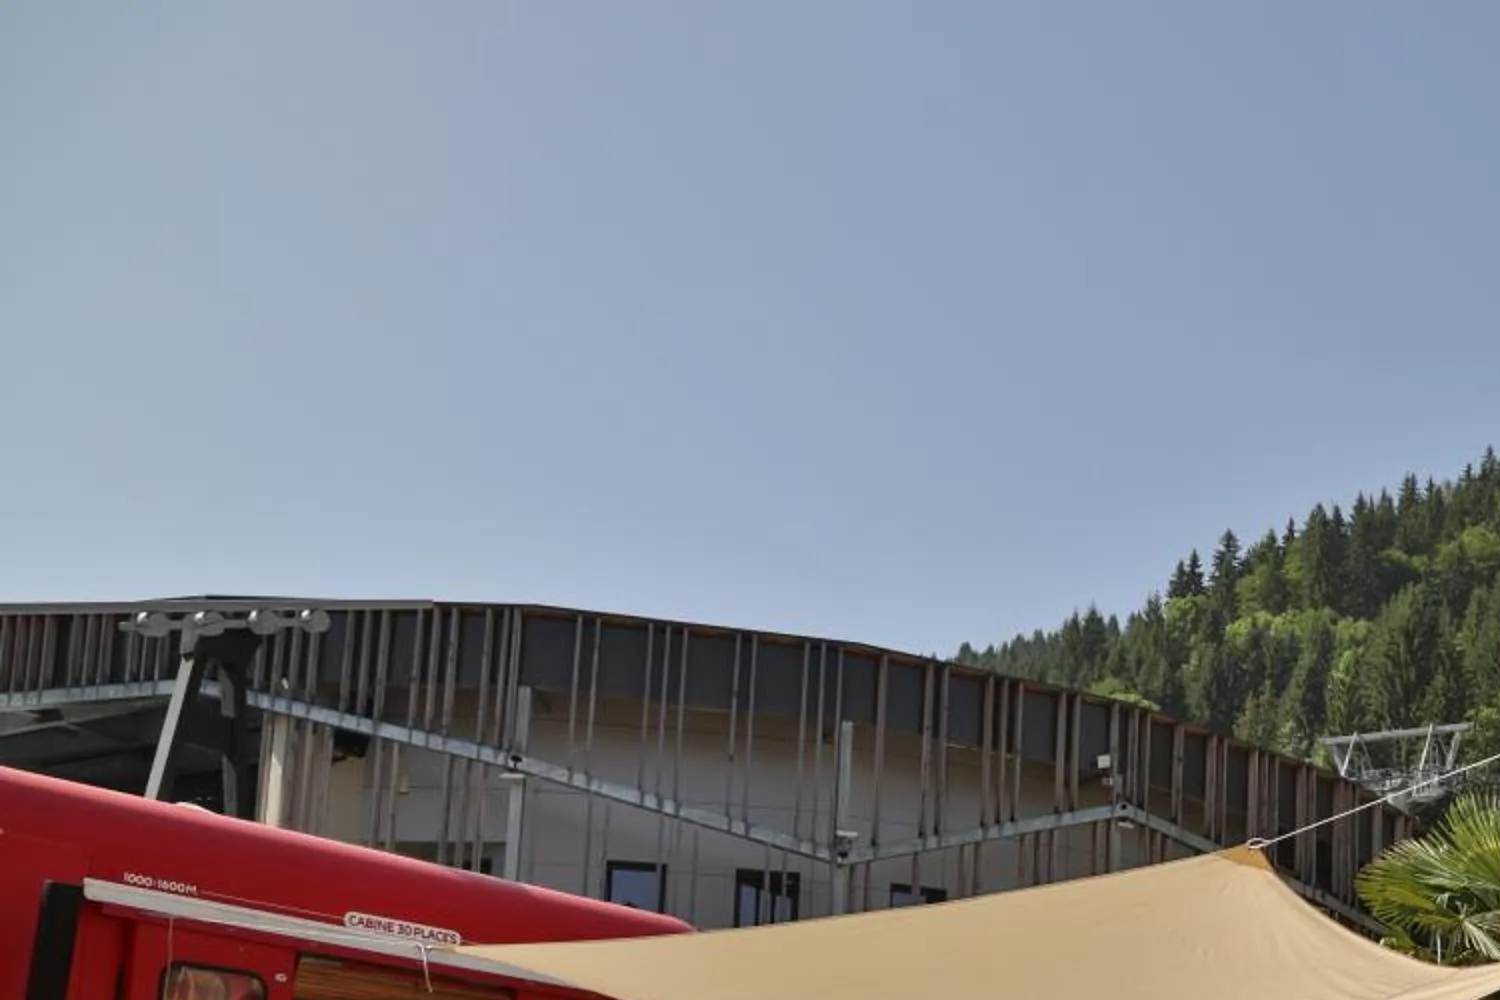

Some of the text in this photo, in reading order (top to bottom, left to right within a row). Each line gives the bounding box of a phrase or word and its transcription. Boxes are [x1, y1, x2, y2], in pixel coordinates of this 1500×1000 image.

[348, 915, 457, 944] CABINE 30 PLACES
